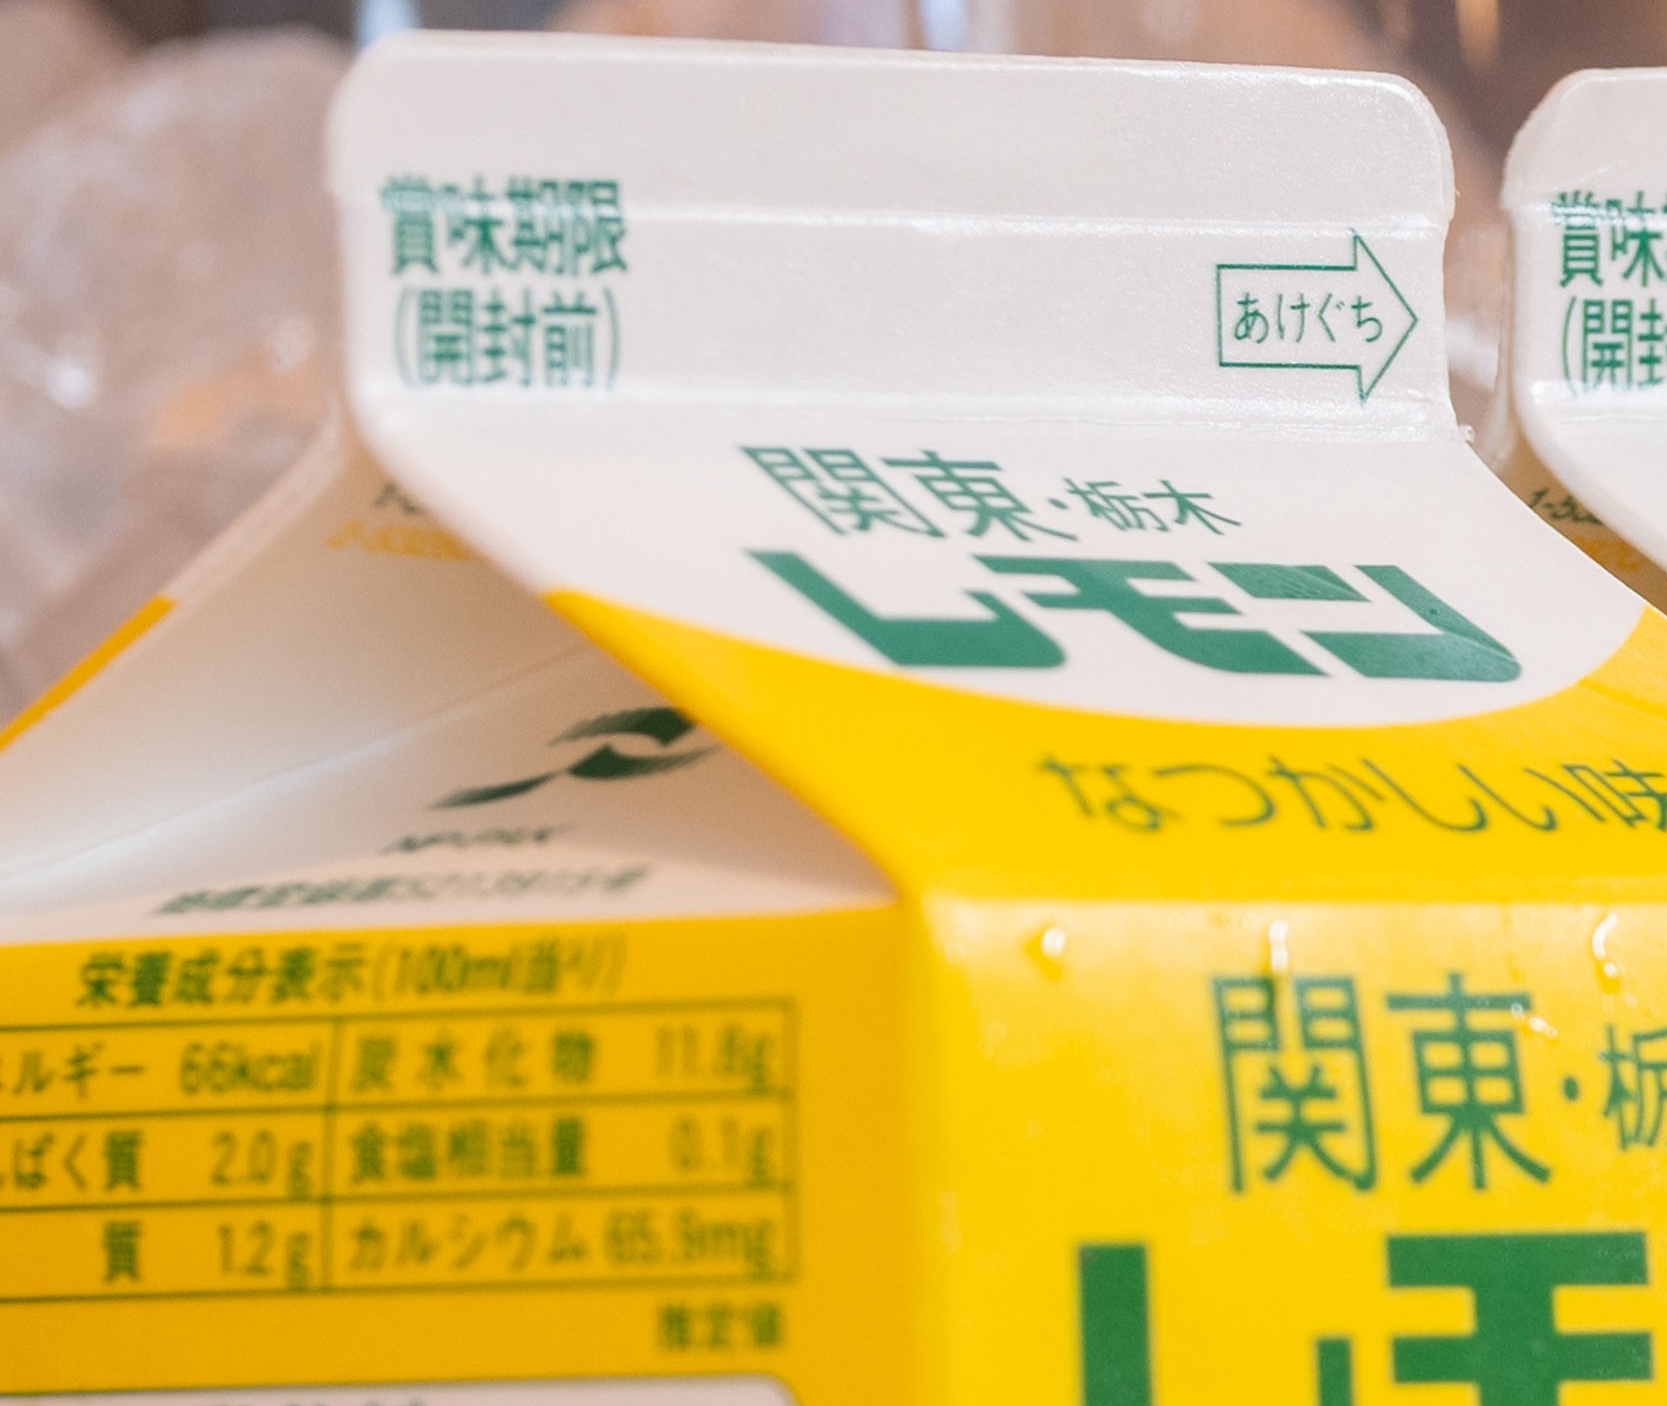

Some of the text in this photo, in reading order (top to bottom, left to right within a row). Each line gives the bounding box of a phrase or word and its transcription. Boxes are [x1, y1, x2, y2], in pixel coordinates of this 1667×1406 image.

[379, 177, 627, 275] 賞味期限
[396, 284, 621, 390] (開封前)
[1232, 292, 1385, 346] あけぐち
[744, 549, 1521, 683] レモン
[0, 1042, 146, 1100] ルギー
